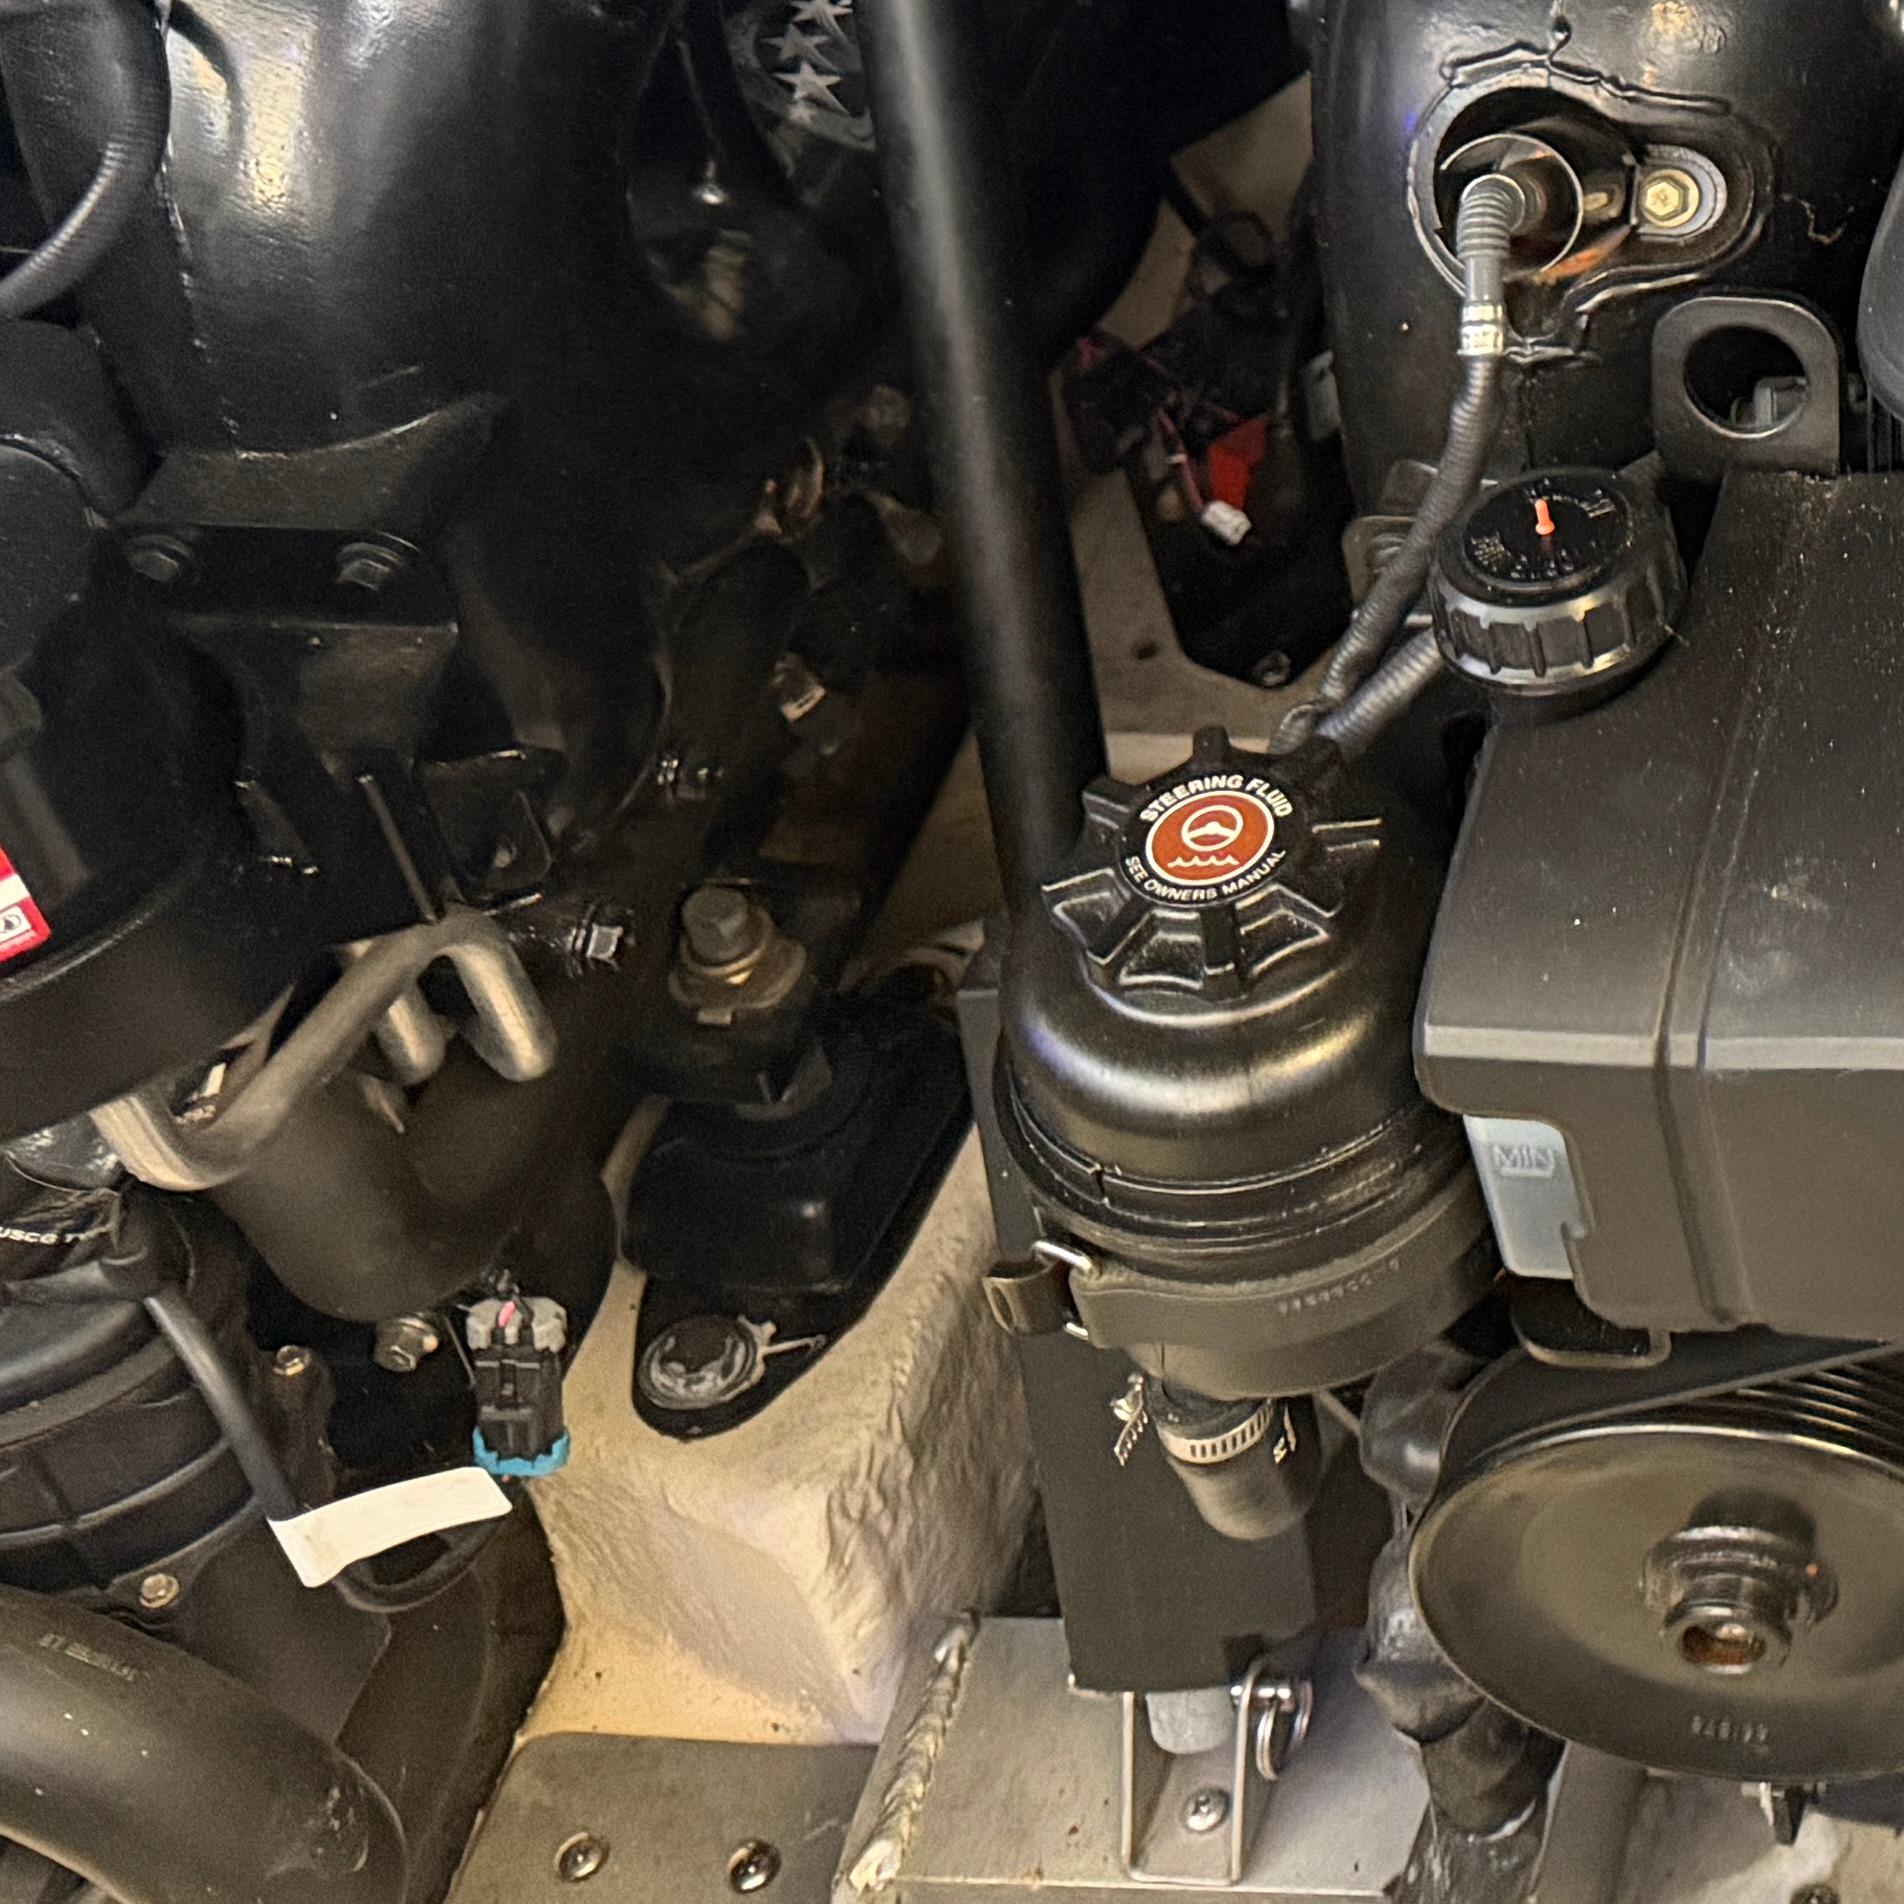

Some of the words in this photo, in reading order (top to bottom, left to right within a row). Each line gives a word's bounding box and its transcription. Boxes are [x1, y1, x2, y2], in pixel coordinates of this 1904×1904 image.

[1139, 773, 1245, 823] STEERING
[1245, 777, 1294, 819] FLUID
[1124, 854, 1146, 886] SEE
[1143, 875, 1218, 902] OWNERS
[1222, 847, 1287, 895] MANUAL
